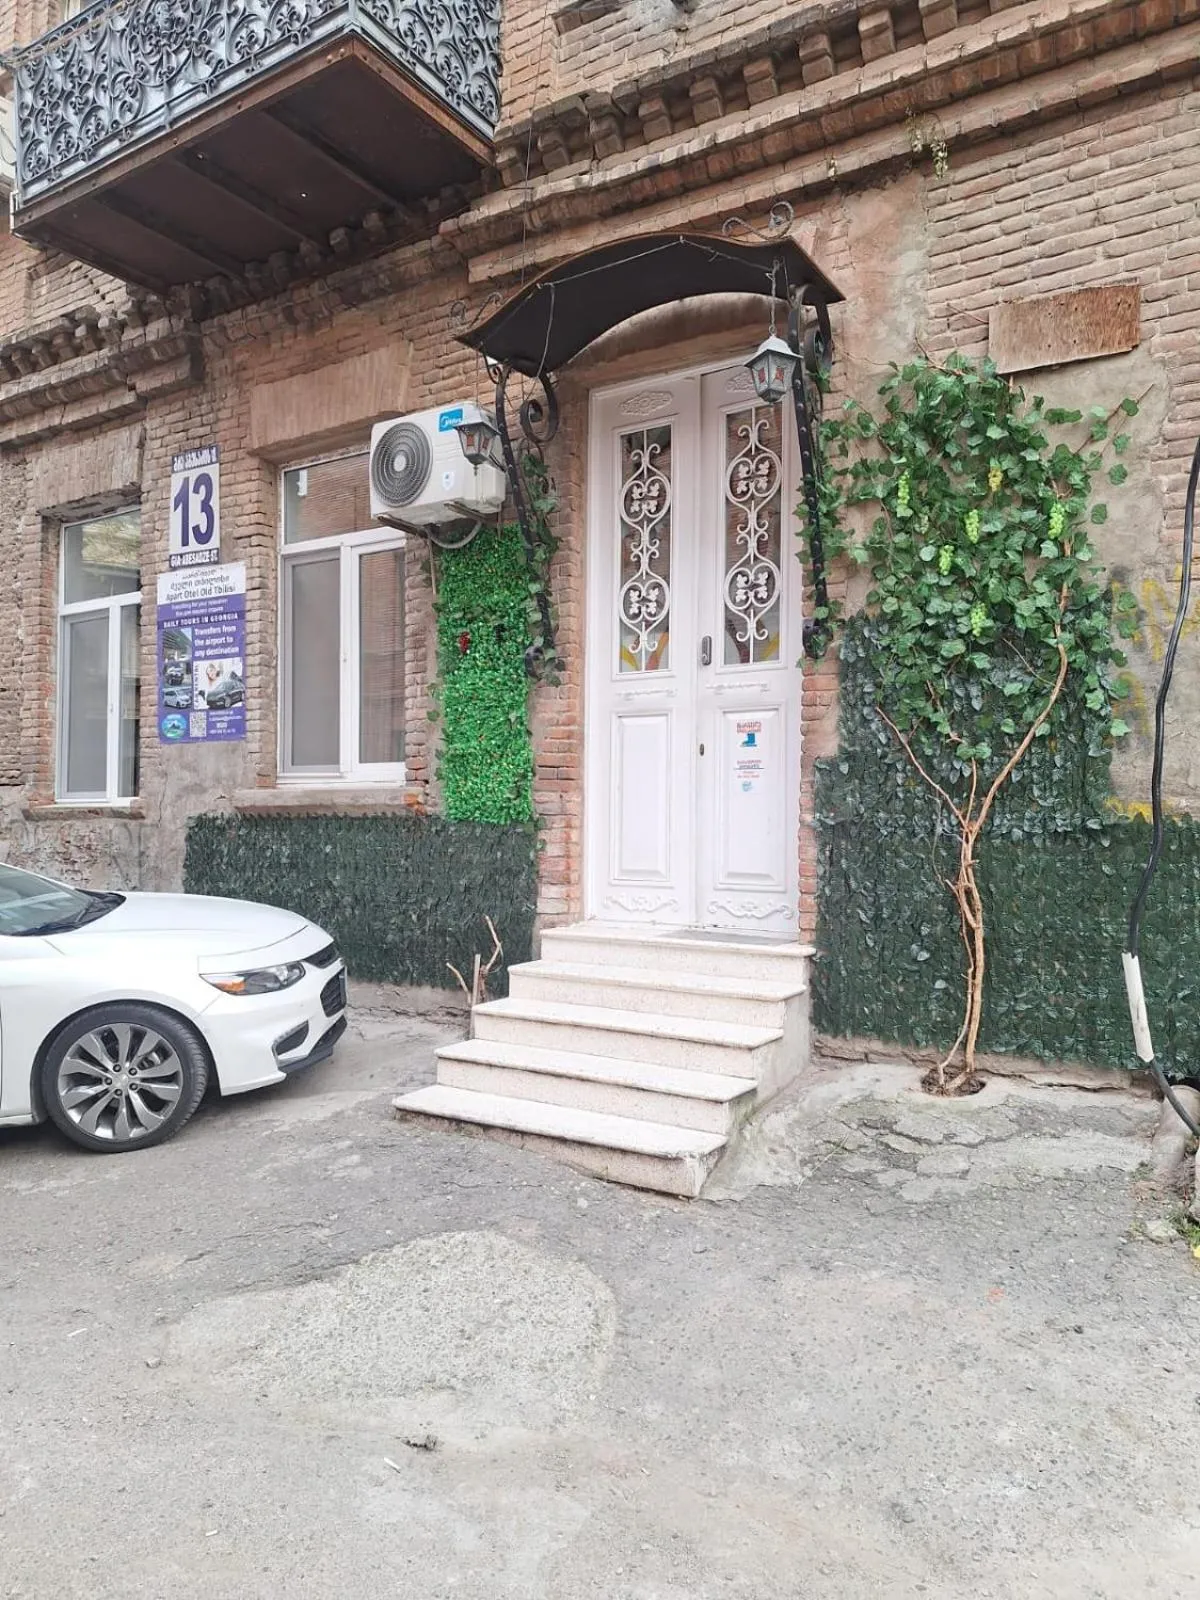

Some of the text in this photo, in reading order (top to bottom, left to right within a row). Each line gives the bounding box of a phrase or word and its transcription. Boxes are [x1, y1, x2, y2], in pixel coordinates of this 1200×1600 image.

[174, 473, 214, 547] 13
[184, 588, 199, 598] Otel
[200, 586, 212, 596] Old
[214, 584, 236, 594] Tbilisi
[210, 613, 238, 622] GEORGIA
[194, 624, 237, 636] Transfers from
[205, 636, 226, 646] airport
[194, 647, 240, 658] any destination
